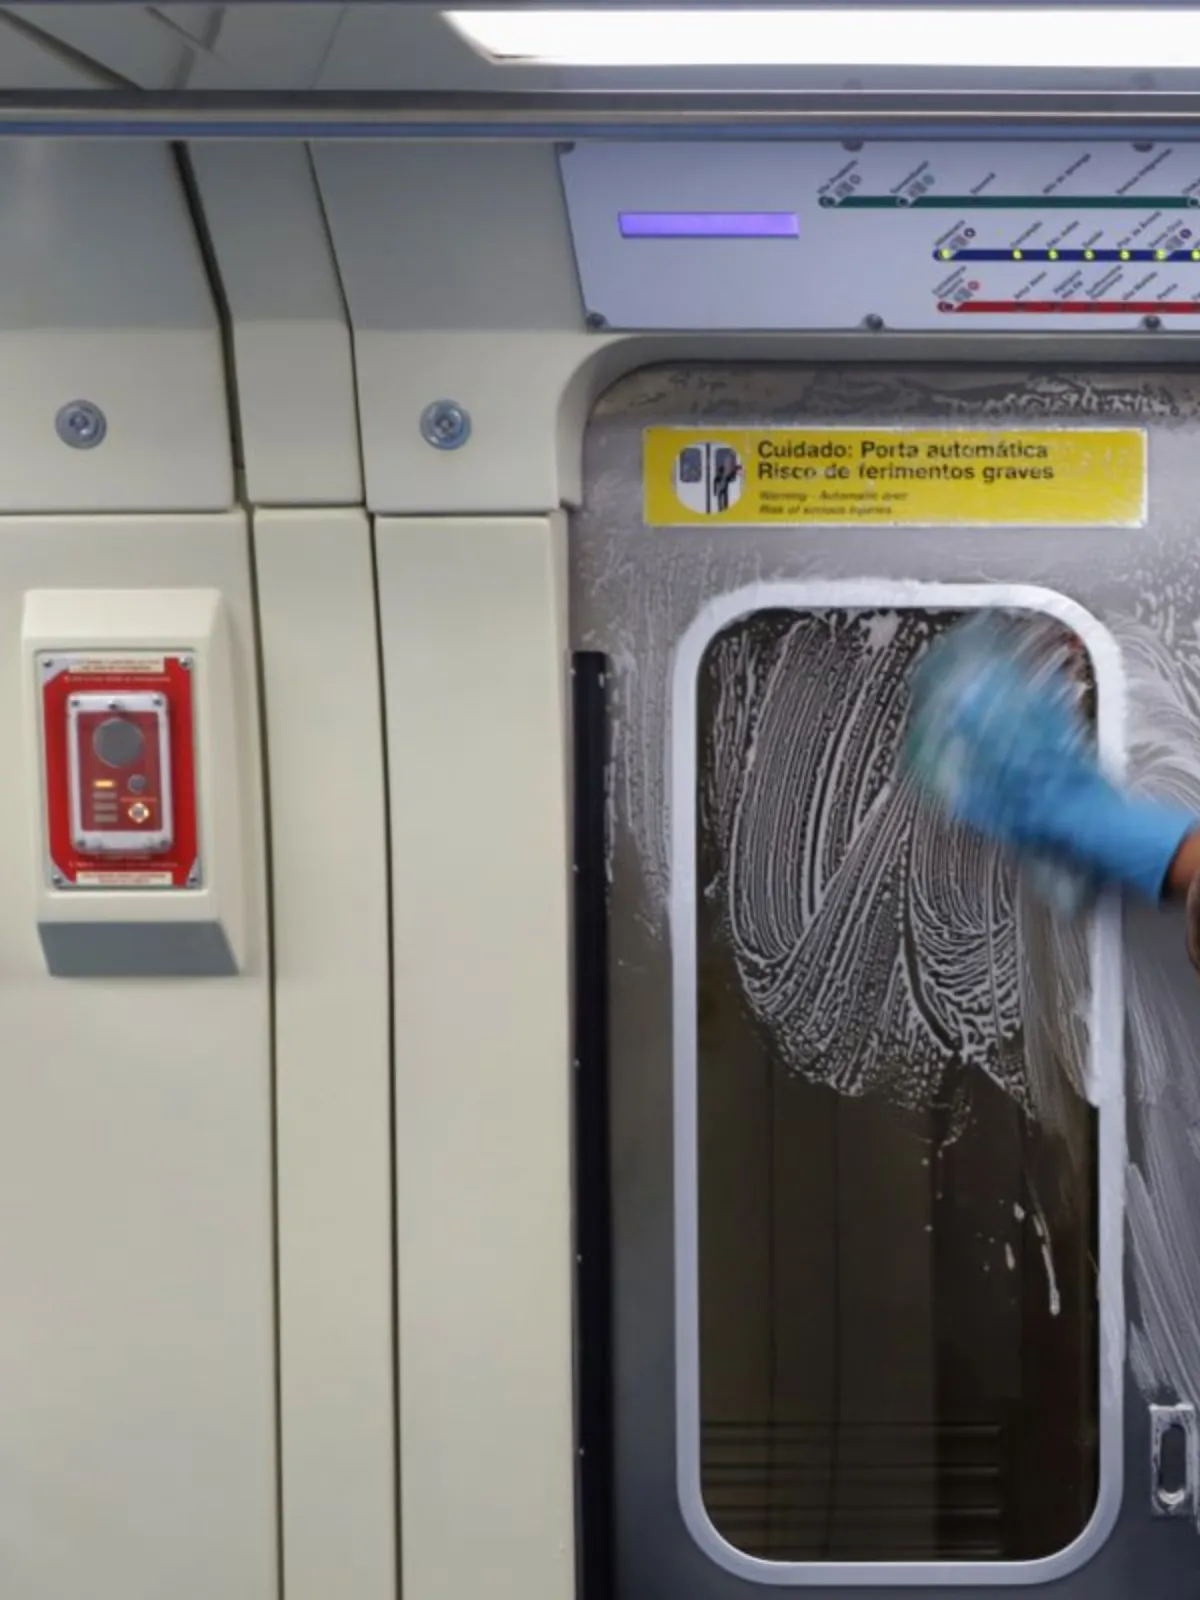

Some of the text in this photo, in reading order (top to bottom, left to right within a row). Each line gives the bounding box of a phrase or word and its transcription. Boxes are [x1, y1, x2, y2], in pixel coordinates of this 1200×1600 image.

[758, 440, 1048, 459] Cuidado: Porta automática
[757, 462, 1054, 484] Risco de ferimentos graves
